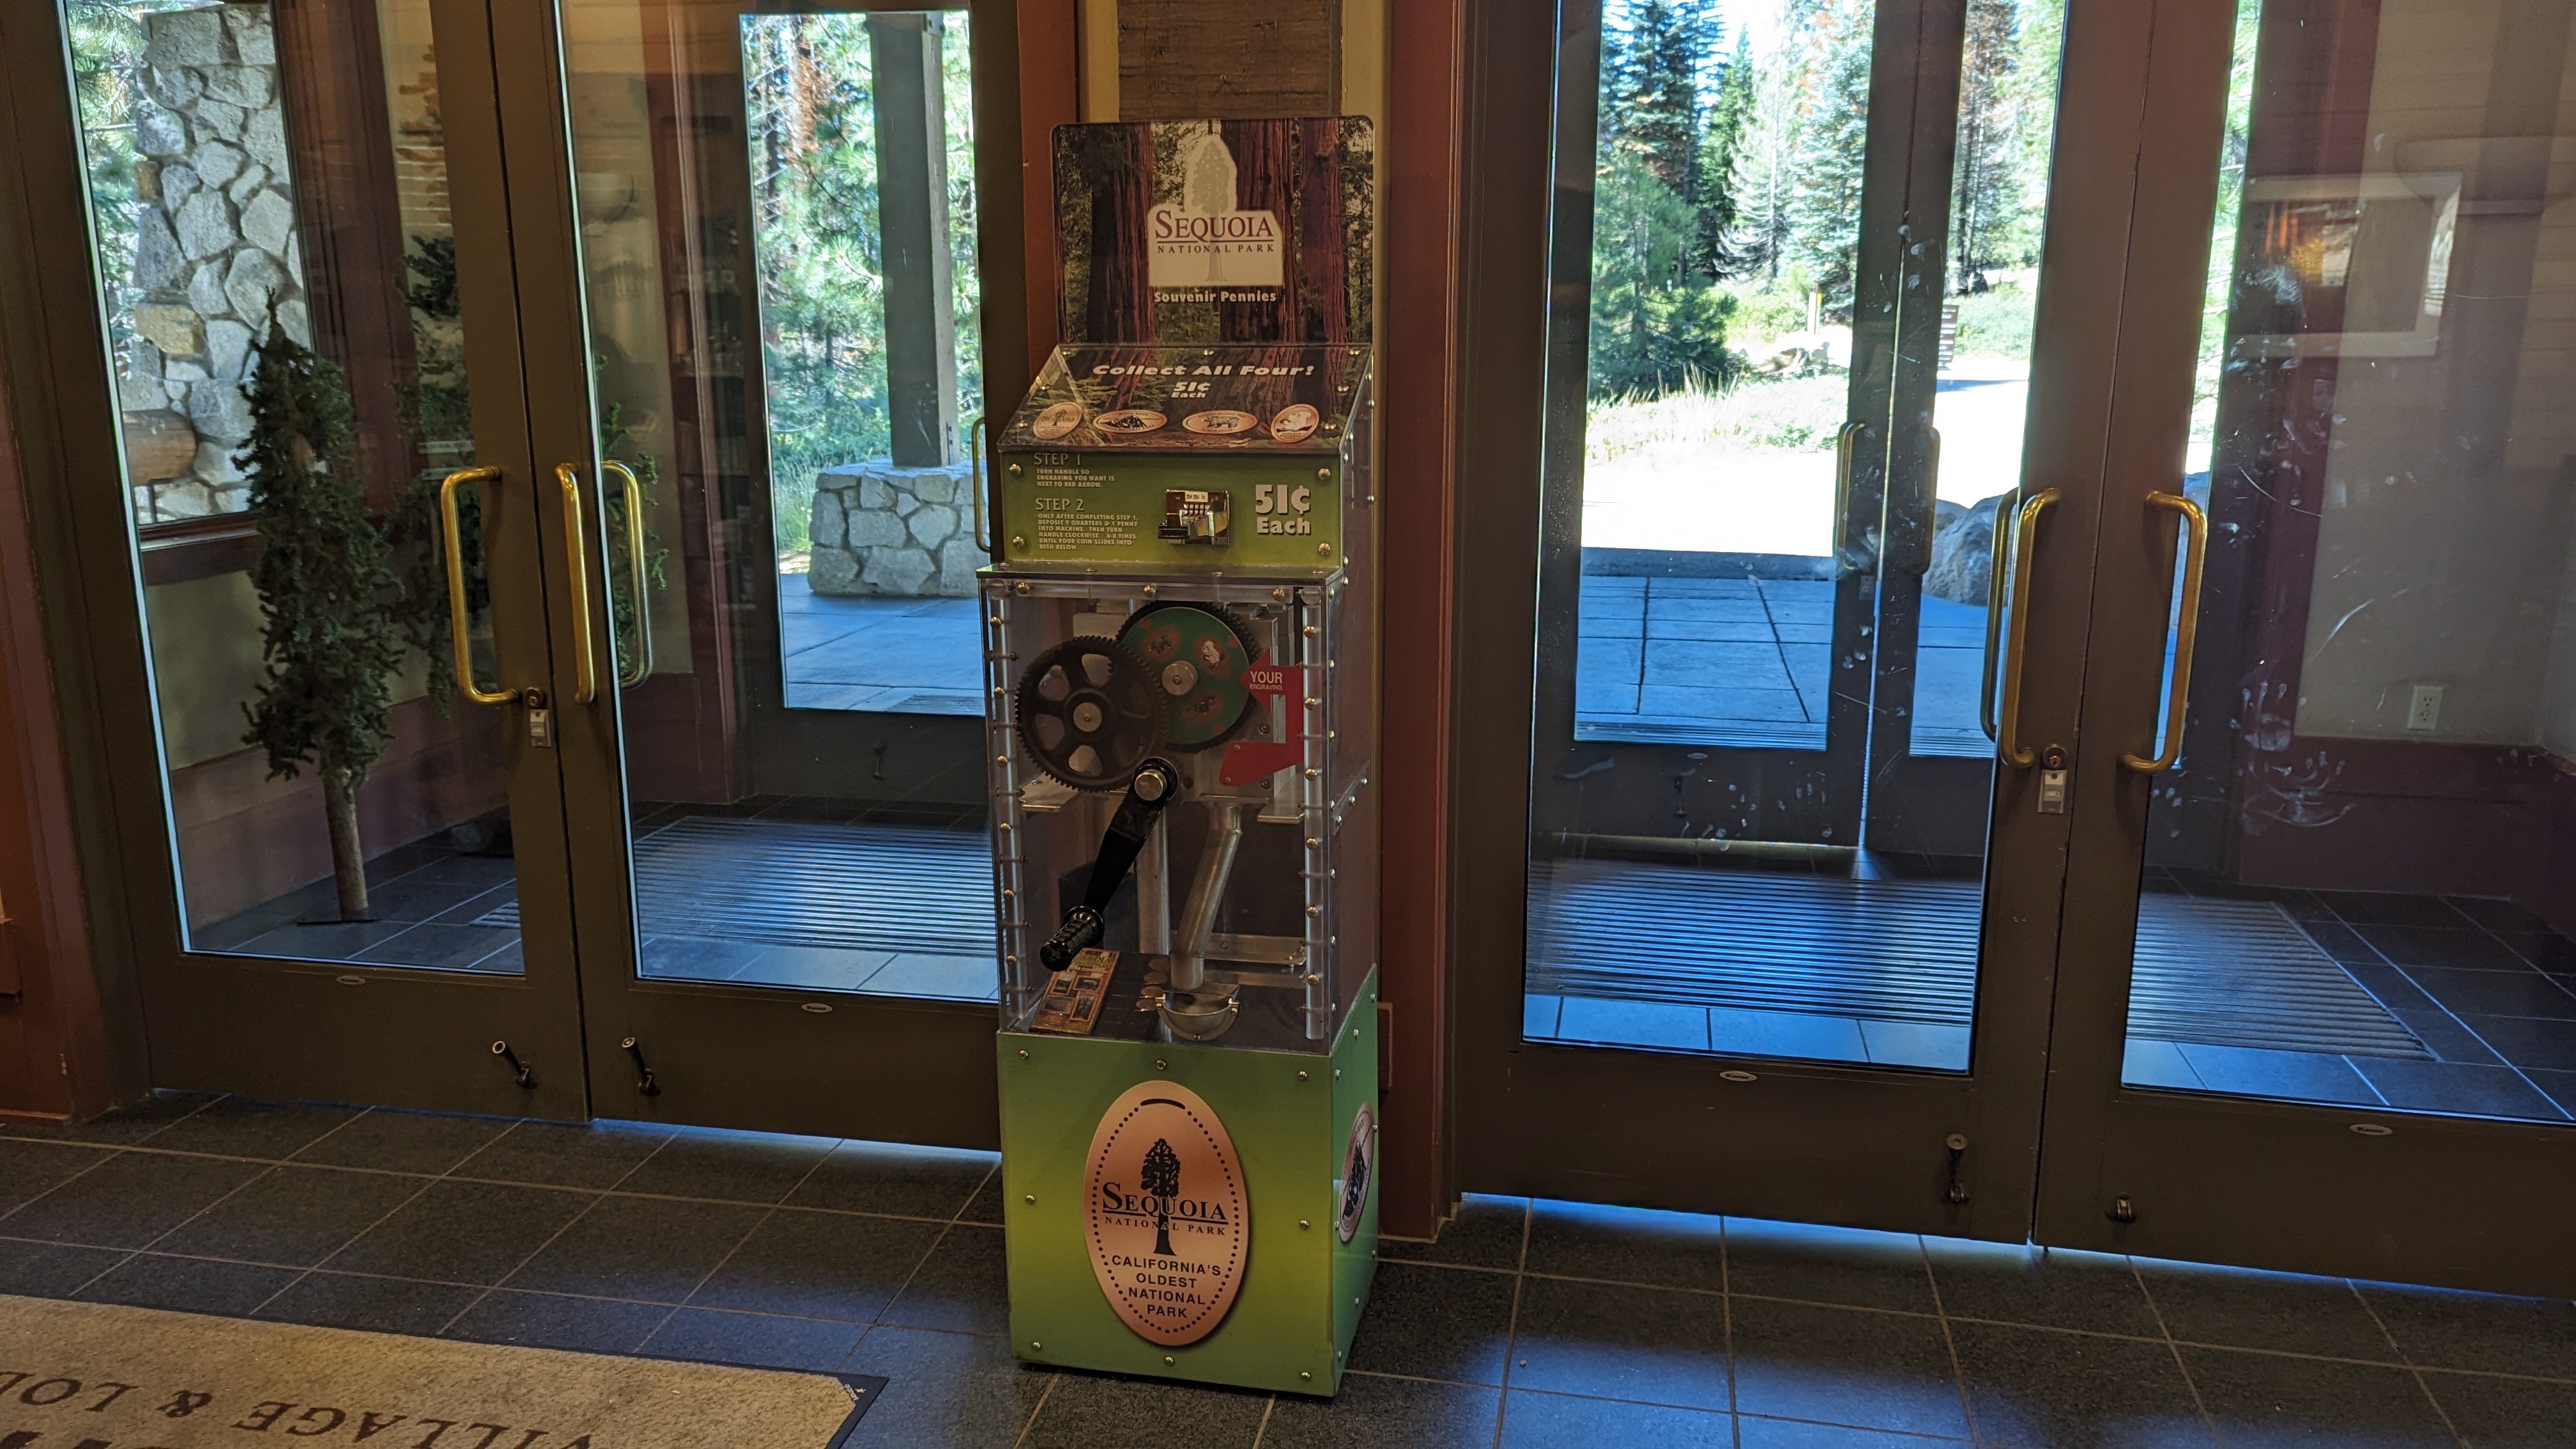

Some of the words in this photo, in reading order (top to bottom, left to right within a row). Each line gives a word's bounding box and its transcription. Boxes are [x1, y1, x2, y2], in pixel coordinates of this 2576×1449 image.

[1155, 210, 1273, 242] SEQUOIA
[1158, 245, 1230, 254] NATIONAL
[1238, 244, 1275, 253] PARK
[1154, 290, 1216, 302] Souvenir
[1220, 290, 1276, 302] Pennies
[1092, 365, 1186, 376] Collect
[1192, 365, 1232, 376] All
[1239, 365, 1315, 376] Four!
[1174, 382, 1211, 392] 51¢
[1034, 453, 1069, 466] STEP
[1077, 454, 1082, 466] 1
[1036, 498, 1070, 511] STEP
[1077, 499, 1085, 511] 2
[1255, 484, 1310, 515] 51¢
[1257, 517, 1310, 534] Each
[1250, 671, 1283, 684] YOUR
[1102, 1182, 1227, 1220] SEQUOIA
[1105, 1216, 1179, 1231] NATIONAL
[1188, 1224, 1225, 1235] PARK
[1112, 1255, 1221, 1276] CALIFORNIA'S
[1136, 1273, 1197, 1289] OLDEST
[1128, 1287, 1206, 1305] NATIONAL
[1147, 1305, 1187, 1318] PARK
[157, 1390, 213, 1418] &
